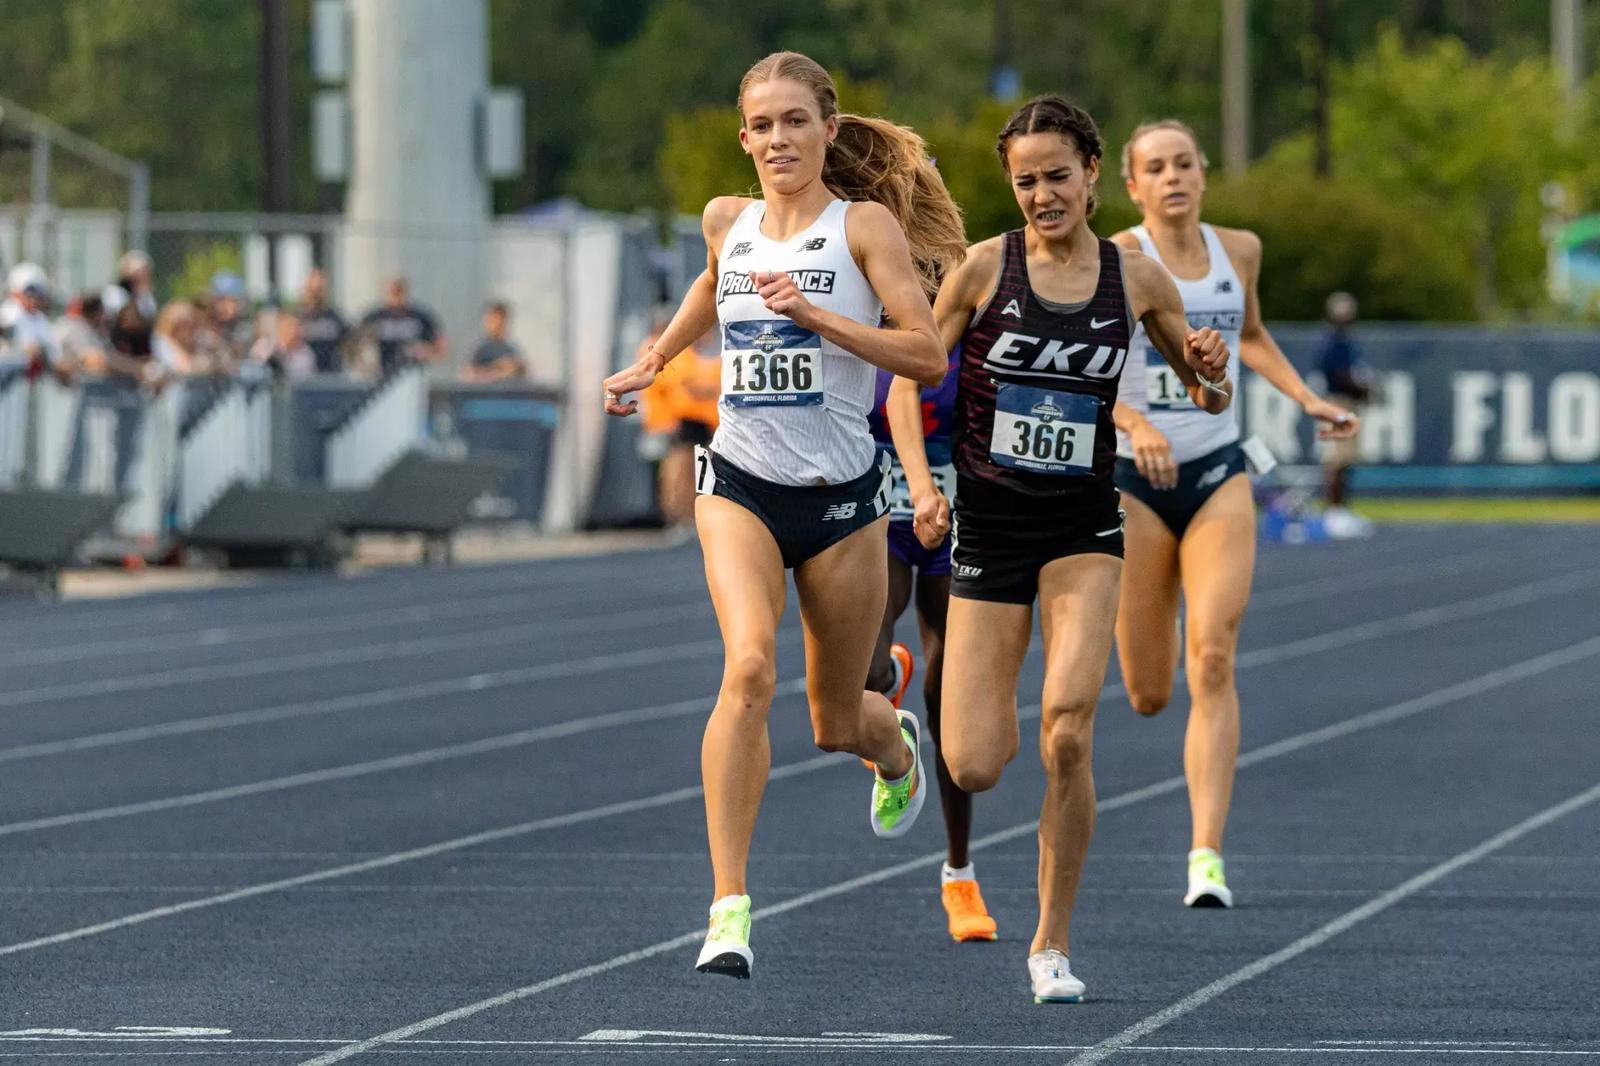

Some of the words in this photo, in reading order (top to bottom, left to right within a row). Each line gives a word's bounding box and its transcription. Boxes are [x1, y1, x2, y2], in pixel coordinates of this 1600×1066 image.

[717, 269, 836, 306] PRONCE
[732, 353, 813, 392] 1366
[985, 331, 1128, 379] EKU
[1011, 420, 1076, 462] 366
[959, 565, 983, 577] EKU
